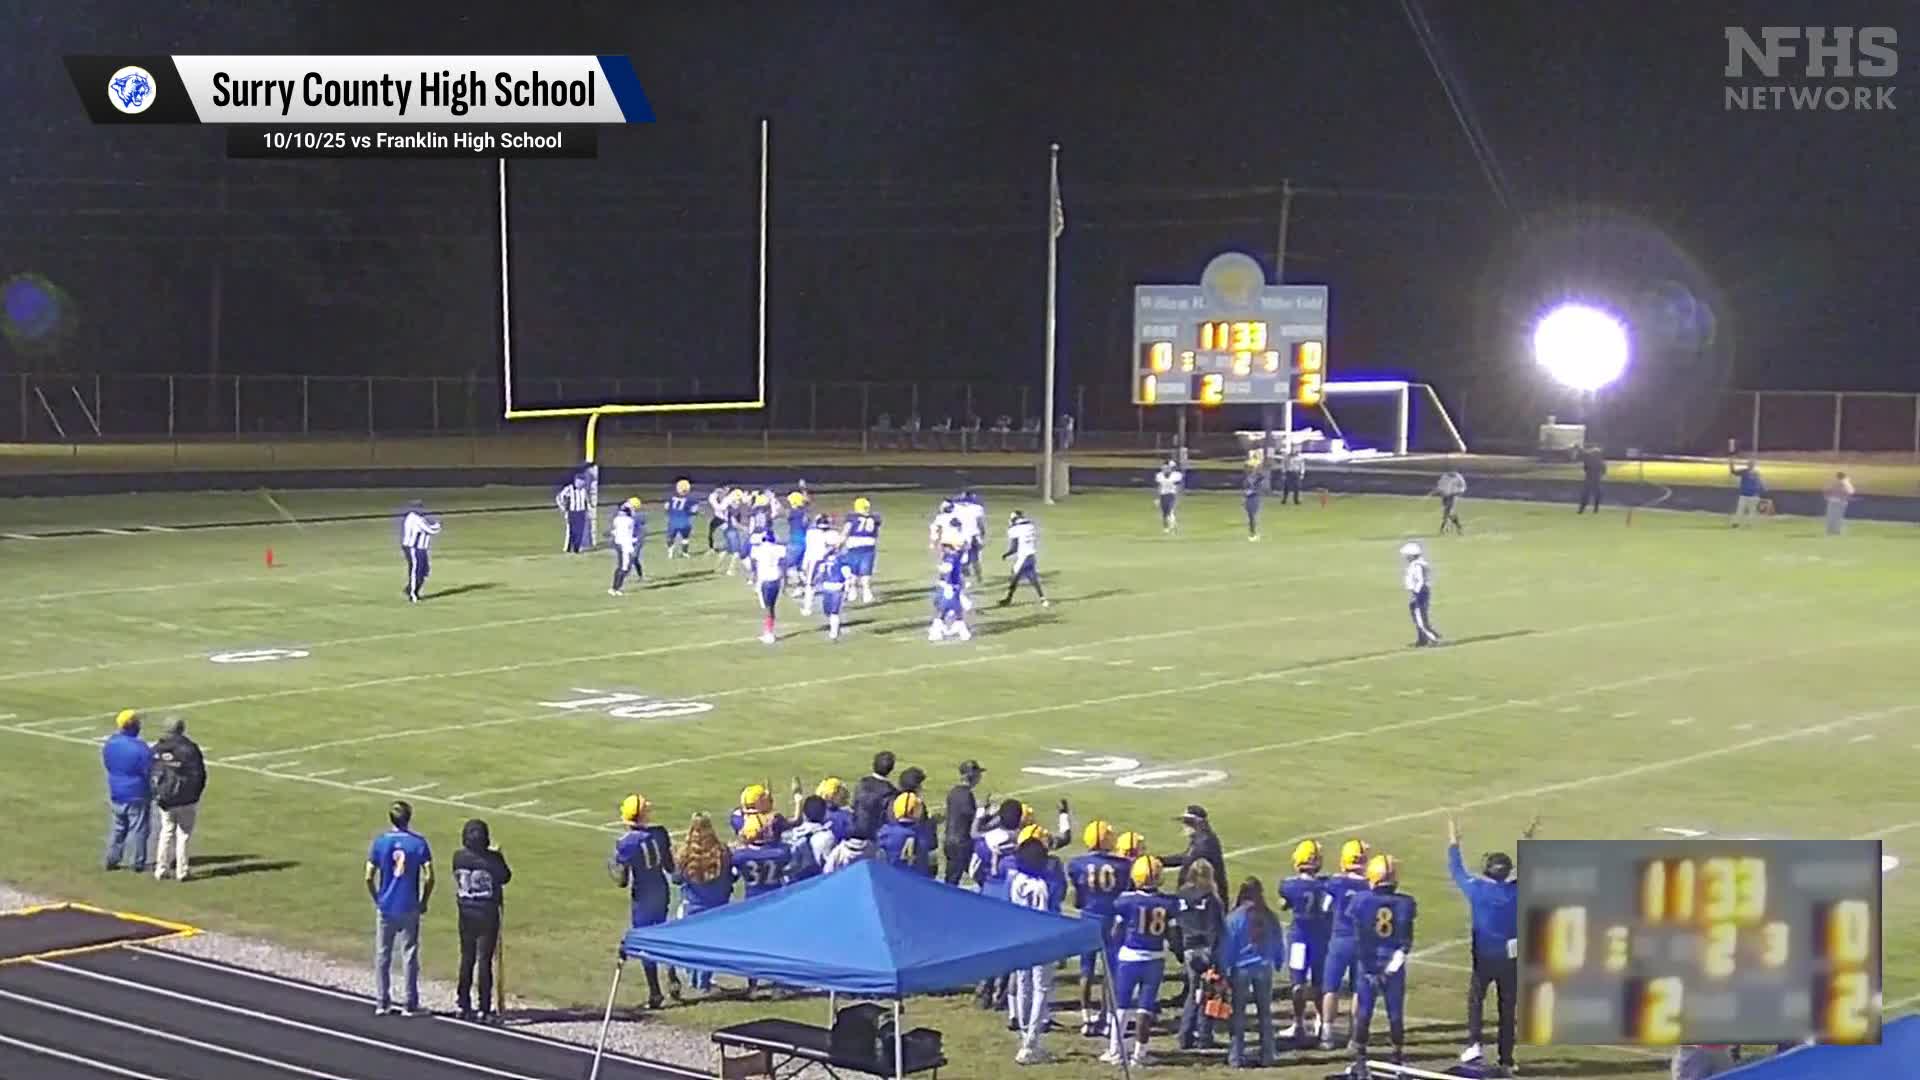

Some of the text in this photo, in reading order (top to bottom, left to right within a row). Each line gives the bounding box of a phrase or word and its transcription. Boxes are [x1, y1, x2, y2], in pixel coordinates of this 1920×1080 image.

[1150, 341, 1173, 373] 0
[1299, 341, 1322, 373] 0
[1200, 373, 1224, 405] 2
[1299, 372, 1322, 405] 2
[537, 687, 714, 718] 10
[1020, 748, 1229, 789] 20
[900, 837, 916, 865] 4
[745, 859, 778, 886] 32
[1086, 863, 1117, 892] 10
[1136, 906, 1167, 937] 18
[1375, 906, 1394, 937] 8
